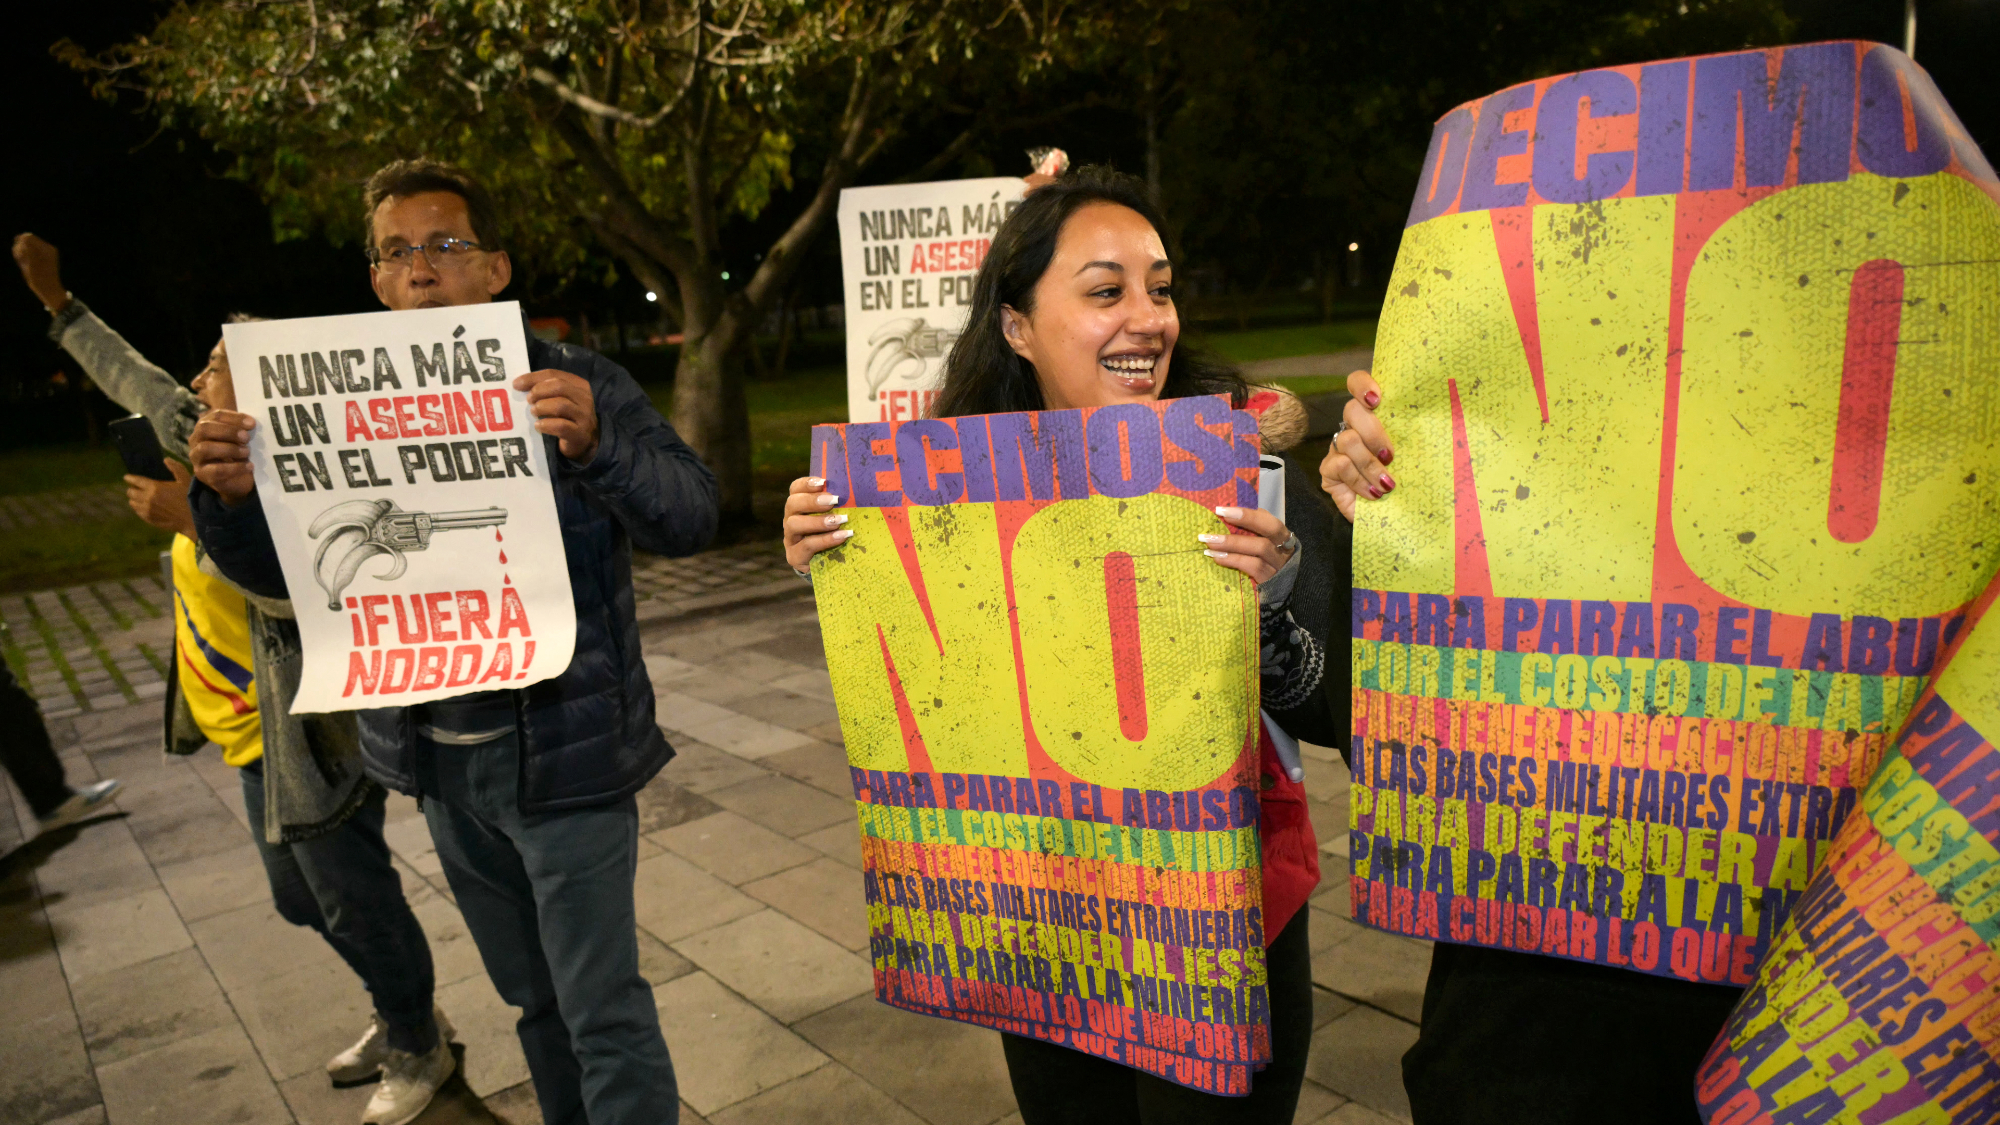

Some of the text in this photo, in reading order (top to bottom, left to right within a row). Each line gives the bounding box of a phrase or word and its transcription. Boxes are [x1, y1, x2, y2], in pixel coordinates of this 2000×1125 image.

[860, 206, 952, 241] NUNCA
[864, 245, 900, 276] UN
[860, 281, 893, 311] EN
[902, 279, 930, 309] EL
[259, 324, 506, 399] NUNCA MÁS
[1352, 171, 2000, 620] NO
[268, 388, 514, 447] UN ASESINO
[809, 394, 1234, 507] DECIMOS
[274, 437, 534, 492] EN EL PODER
[345, 587, 532, 647] ¡FUERA
[810, 492, 1248, 793] NO
[1352, 588, 1486, 649] PARA
[1502, 597, 1699, 661] PARAR
[1714, 606, 1783, 667] EL
[342, 641, 536, 698] NOBOA!
[1352, 637, 1440, 698] POR
[1452, 647, 1506, 704] EL
[1520, 652, 1691, 718] COSTO
[1704, 662, 1777, 724] DE
[1788, 669, 1862, 732] LA
[1352, 687, 1437, 747] PARA
[1446, 699, 1561, 760] TENER
[1569, 710, 1809, 784] EDUCACIÓN
[1896, 692, 2000, 853] PAR
[849, 765, 1259, 832] PARA PARAR EL ABUSO
[1351, 735, 1366, 786] A
[1373, 739, 1428, 795] LAS
[1435, 748, 1537, 807] BASES
[1546, 760, 1731, 831] MILITARES
[856, 800, 1260, 873] POR EL COSTO DE LA VIDA
[862, 834, 921, 876] PARA
[921, 843, 997, 885] TENER
[999, 847, 1139, 904] EDUCACIÓN
[1349, 782, 1470, 848] PARA
[1484, 802, 1763, 888] DEFENDER
[882, 872, 921, 910] LAS
[922, 877, 989, 916] BASES
[991, 882, 1102, 933] MILITARES
[1105, 898, 1264, 949] EXTRANJERAS
[1349, 828, 1454, 894] PARA
[1466, 849, 1624, 918] PARAR
[1634, 873, 1668, 926] A
[1680, 878, 1743, 934] LA
[874, 901, 1268, 989] PARA DEFENDER AL IESS
[1350, 874, 1757, 984] PARA CUIDAR LO QUE
[881, 935, 953, 980] PARA
[955, 946, 1052, 994] PARAR
[1061, 961, 1082, 998] A
[1085, 964, 1124, 1007] LA
[886, 966, 949, 1008] PARA
[951, 977, 1046, 1023] CUIDAR
[1048, 992, 1083, 1029] LO
[1086, 998, 1138, 1043] QUE
[1142, 1010, 1271, 1061] IMPORTA
